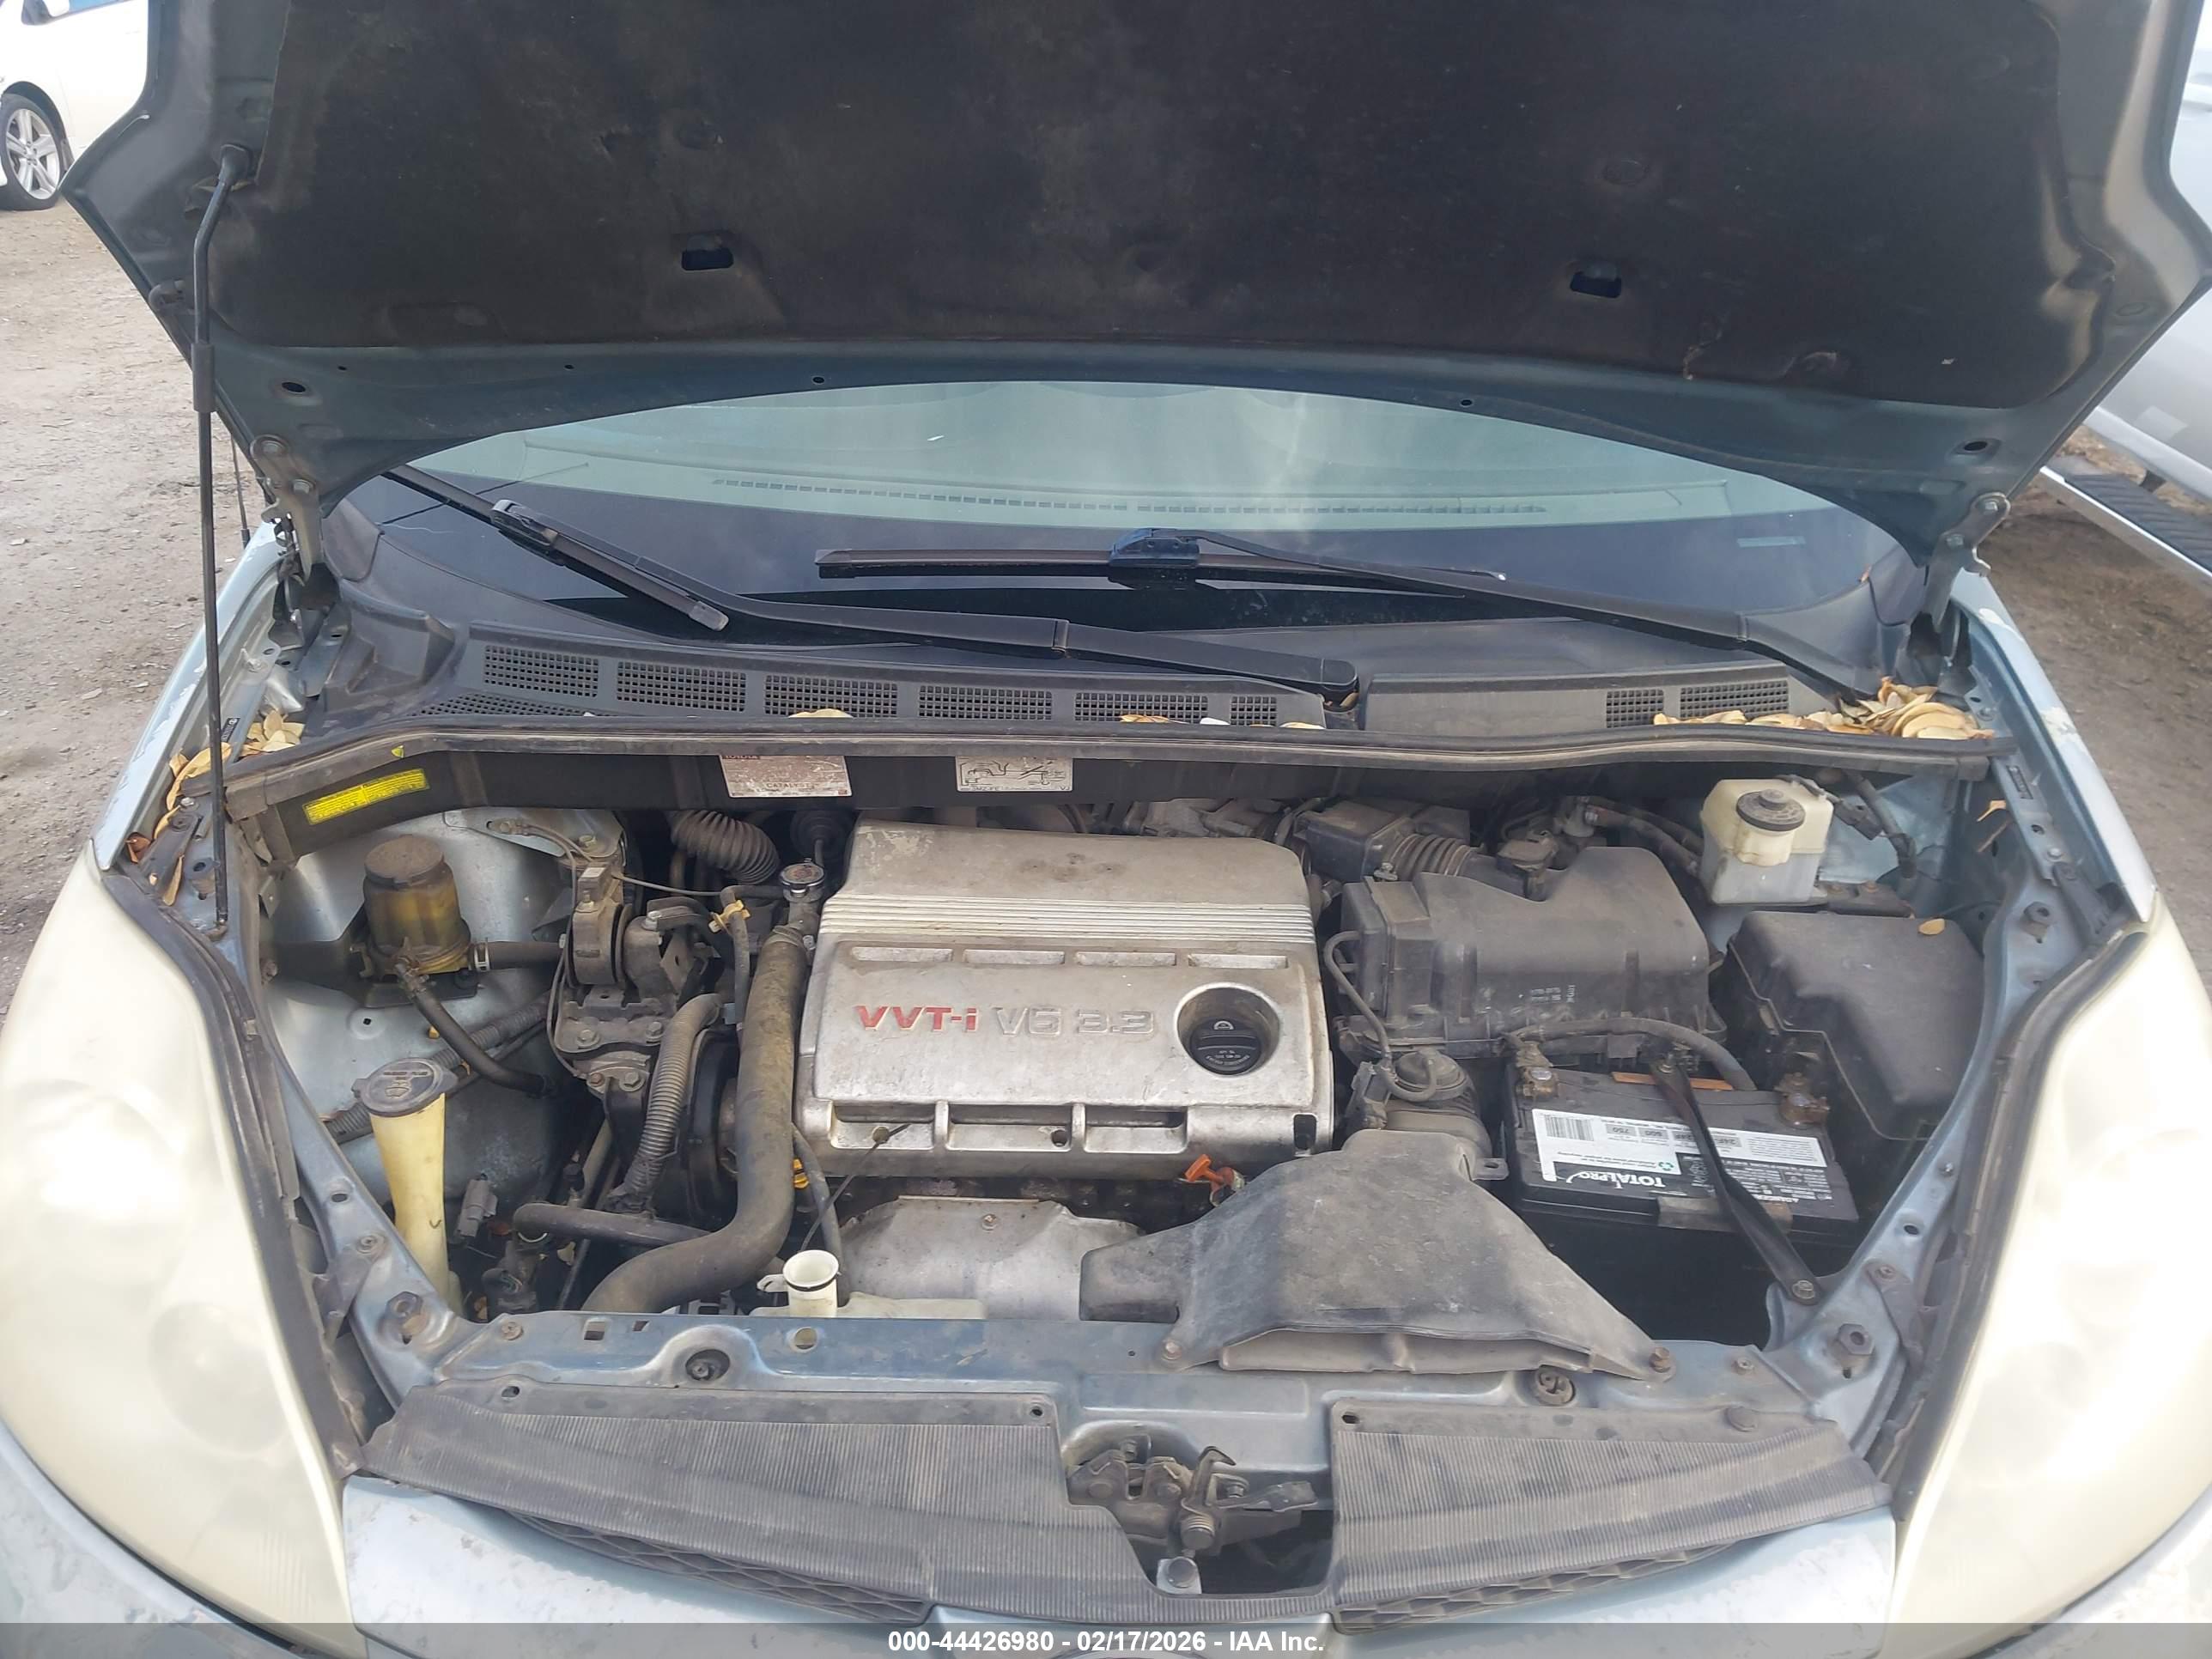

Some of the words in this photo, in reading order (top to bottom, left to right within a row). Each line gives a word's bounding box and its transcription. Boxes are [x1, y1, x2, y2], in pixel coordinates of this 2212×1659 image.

[854, 1005, 977, 1031] VVT-i
[992, 1006, 1061, 1036] V6
[1077, 1008, 1154, 1035] 3.3
[1577, 1170, 1666, 1189] TOTALPRO
